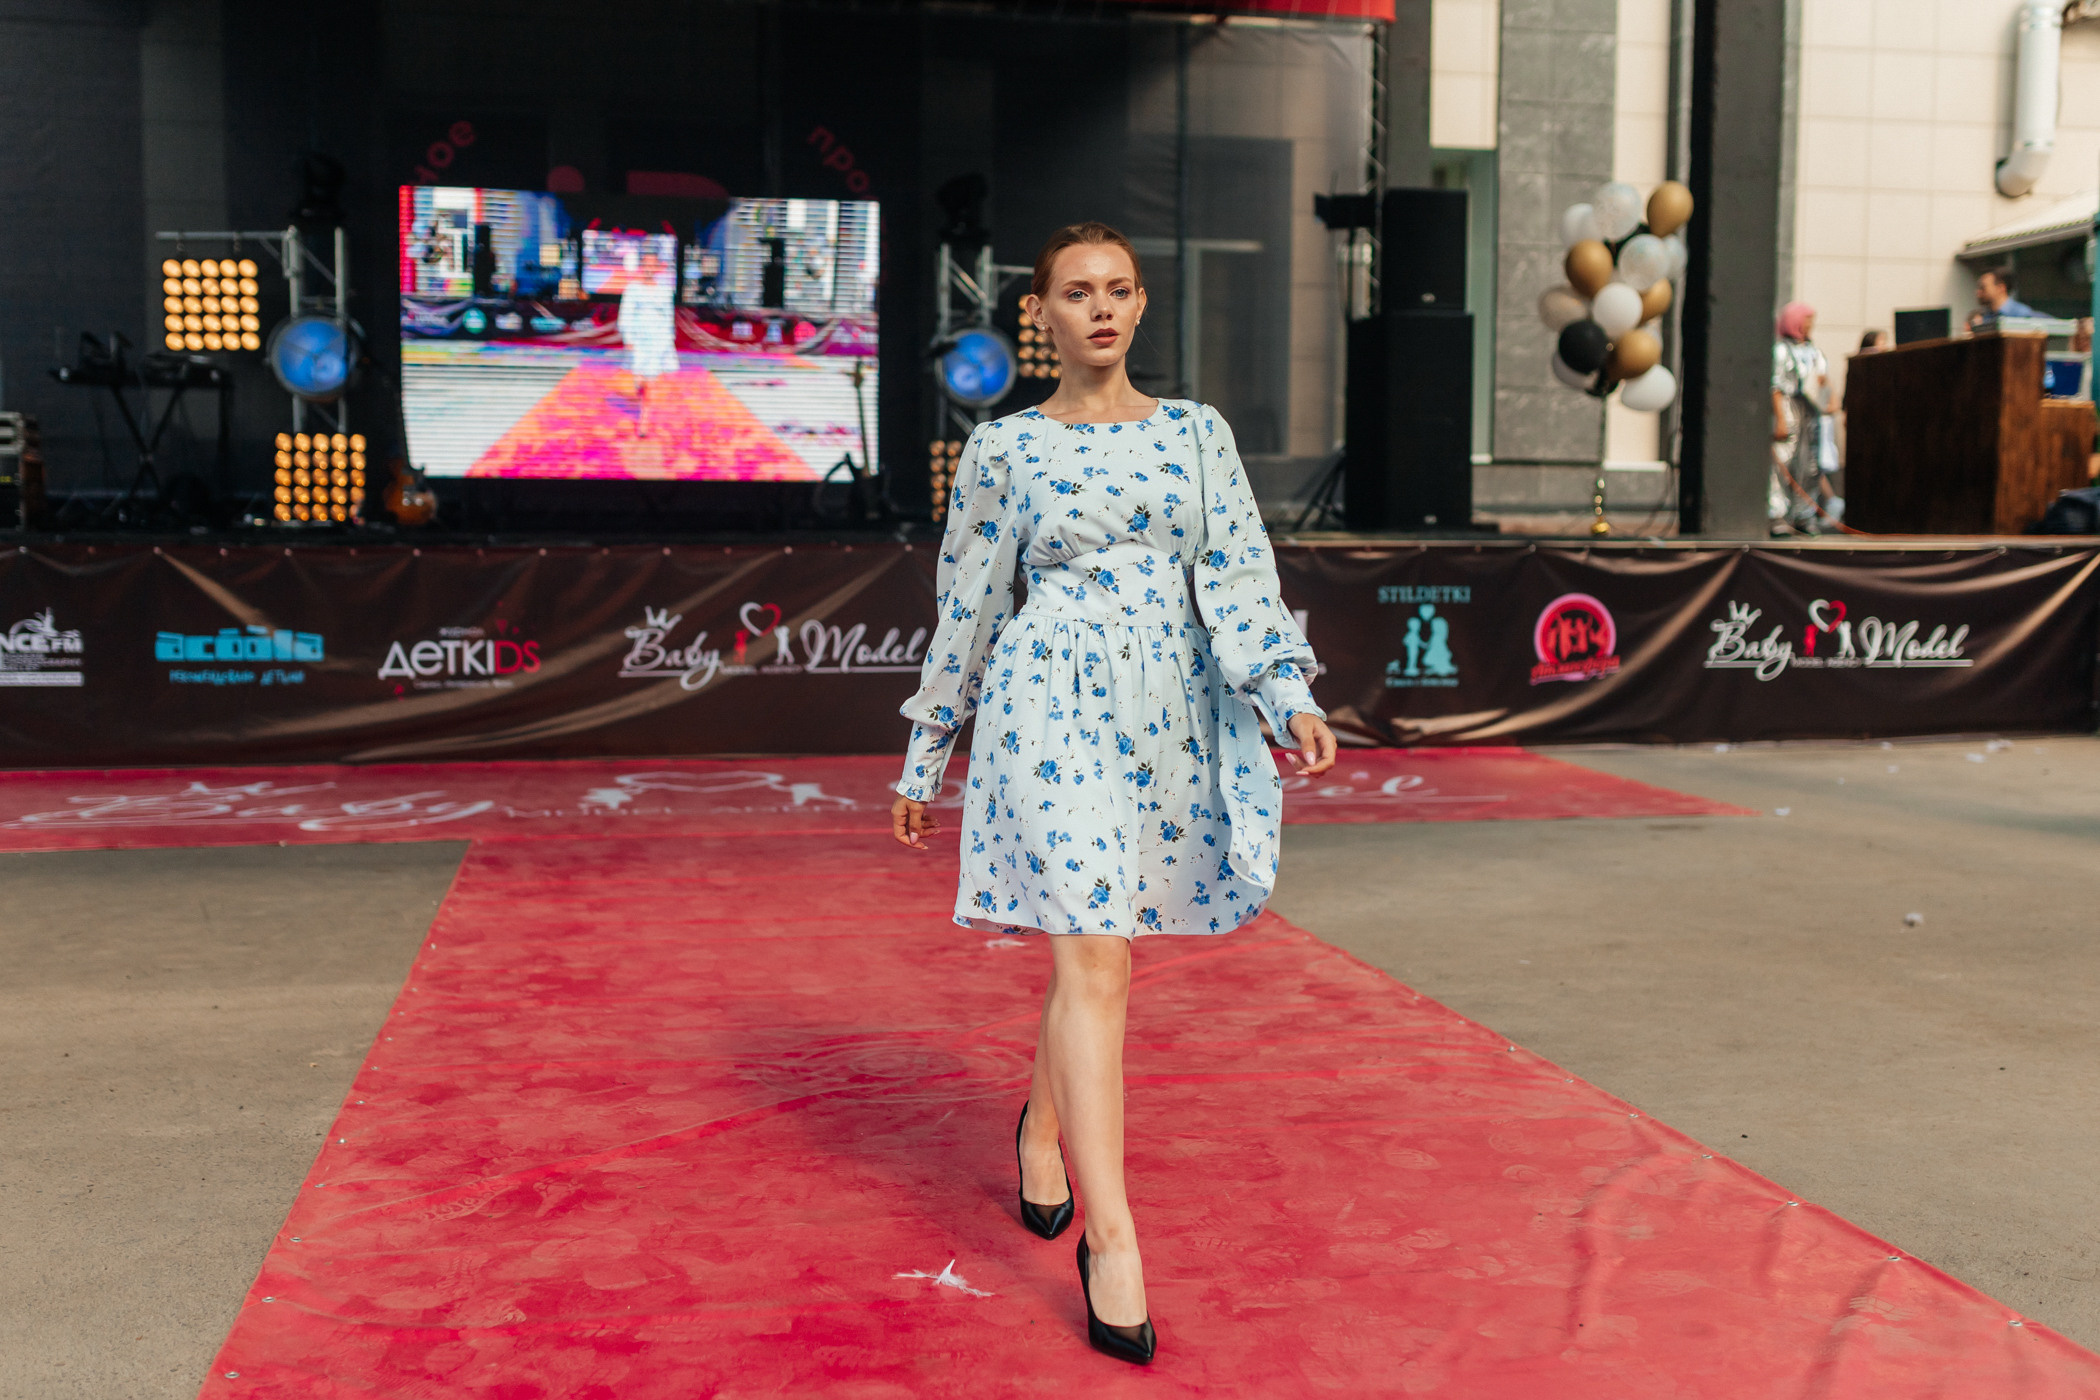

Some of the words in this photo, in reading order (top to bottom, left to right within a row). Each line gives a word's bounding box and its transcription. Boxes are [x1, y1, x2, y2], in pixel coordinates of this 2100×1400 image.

[1378, 586, 1471, 603] STILDETKI
[624, 624, 723, 691] Baby
[801, 620, 927, 672] Model
[1708, 619, 1793, 682] Baby
[1858, 616, 1970, 667] Model
